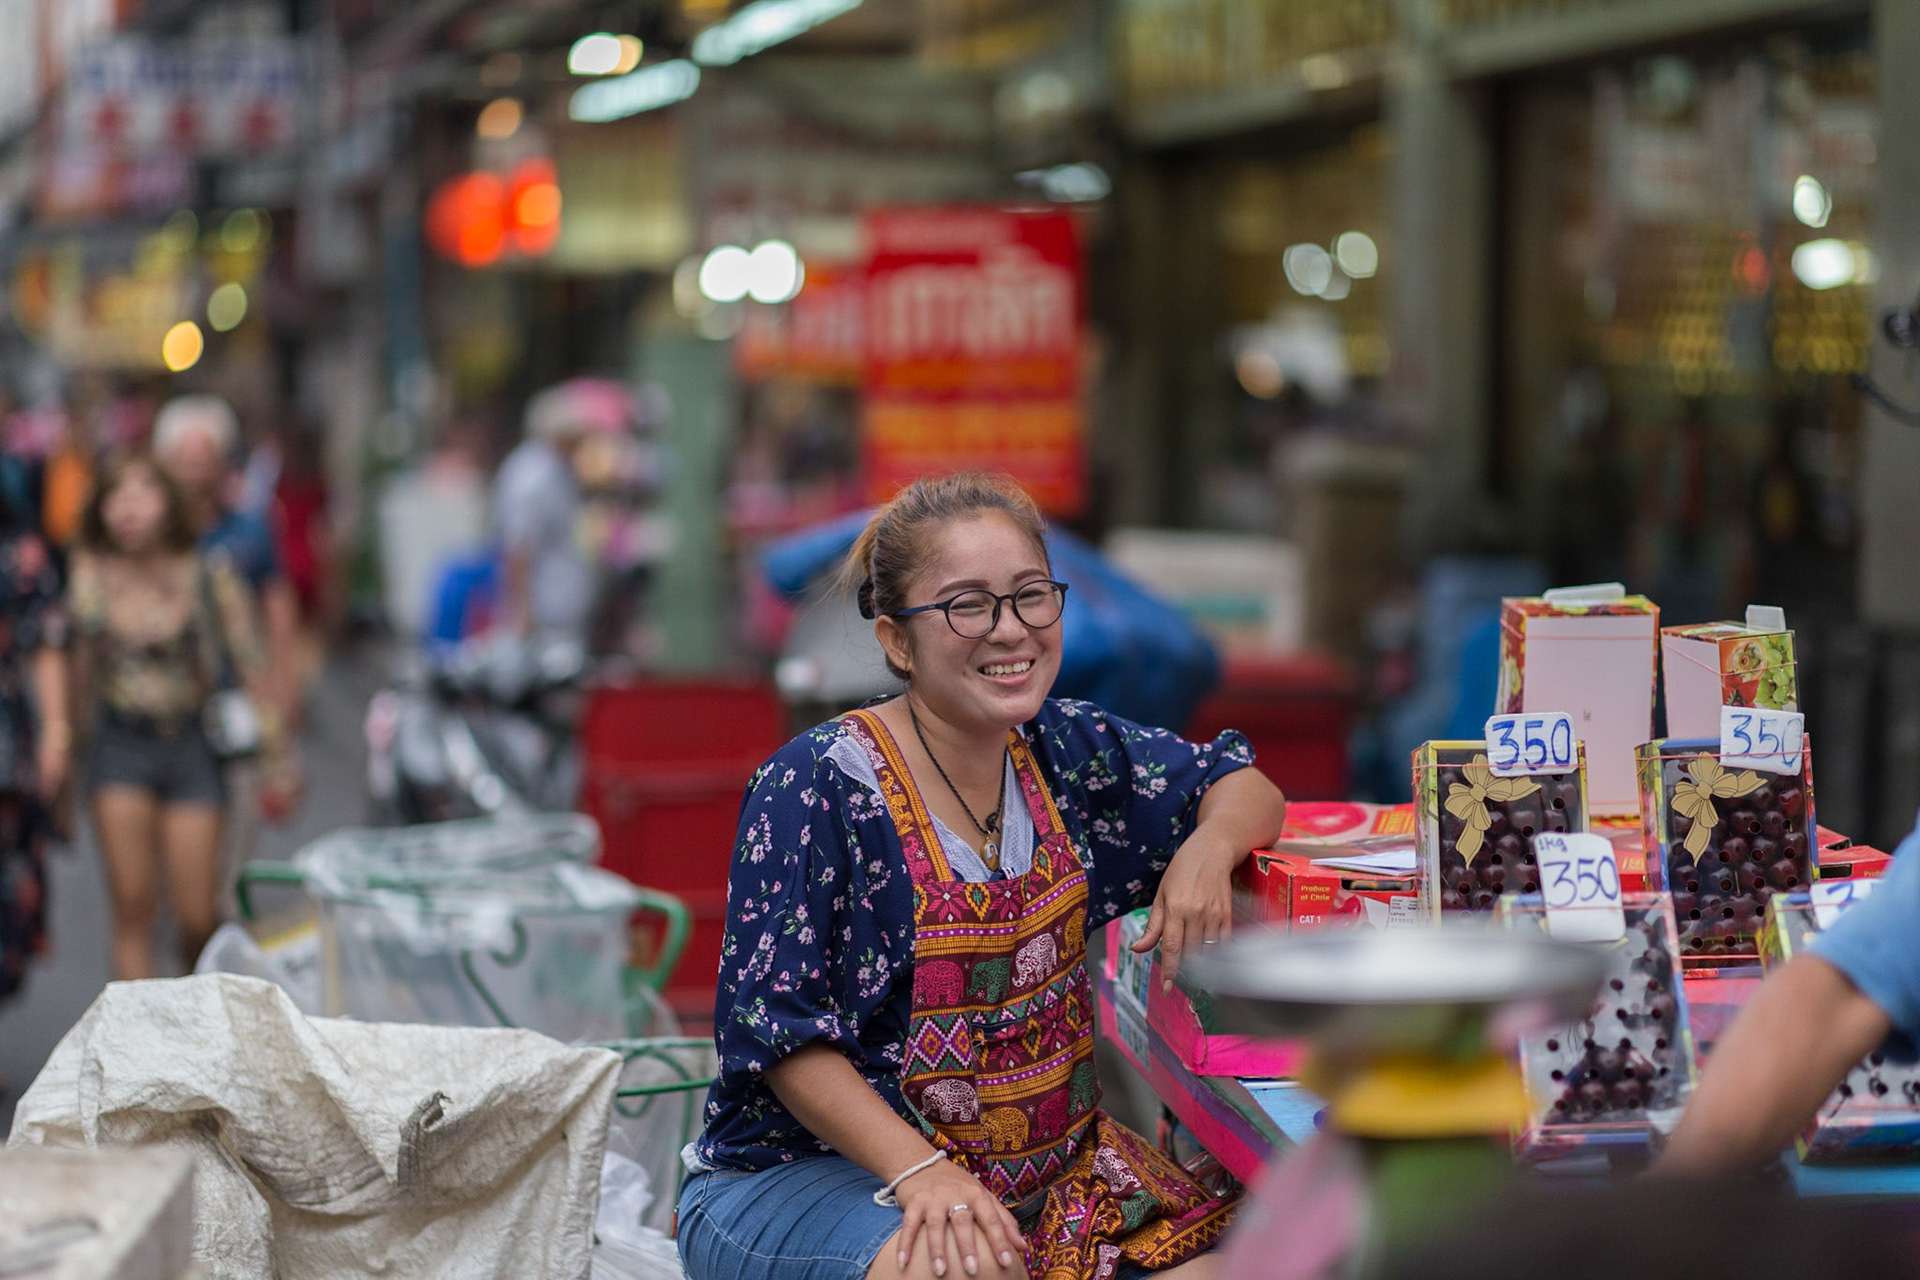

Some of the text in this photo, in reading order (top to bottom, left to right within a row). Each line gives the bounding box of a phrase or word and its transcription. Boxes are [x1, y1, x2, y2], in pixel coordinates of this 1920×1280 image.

[1492, 718, 1571, 771] 350
[1728, 714, 1803, 769] 350
[1300, 884, 1331, 893] Produce
[1300, 893, 1331, 901] of Chile
[1543, 855, 1619, 908] 350
[1299, 915, 1321, 924] CAT 1
